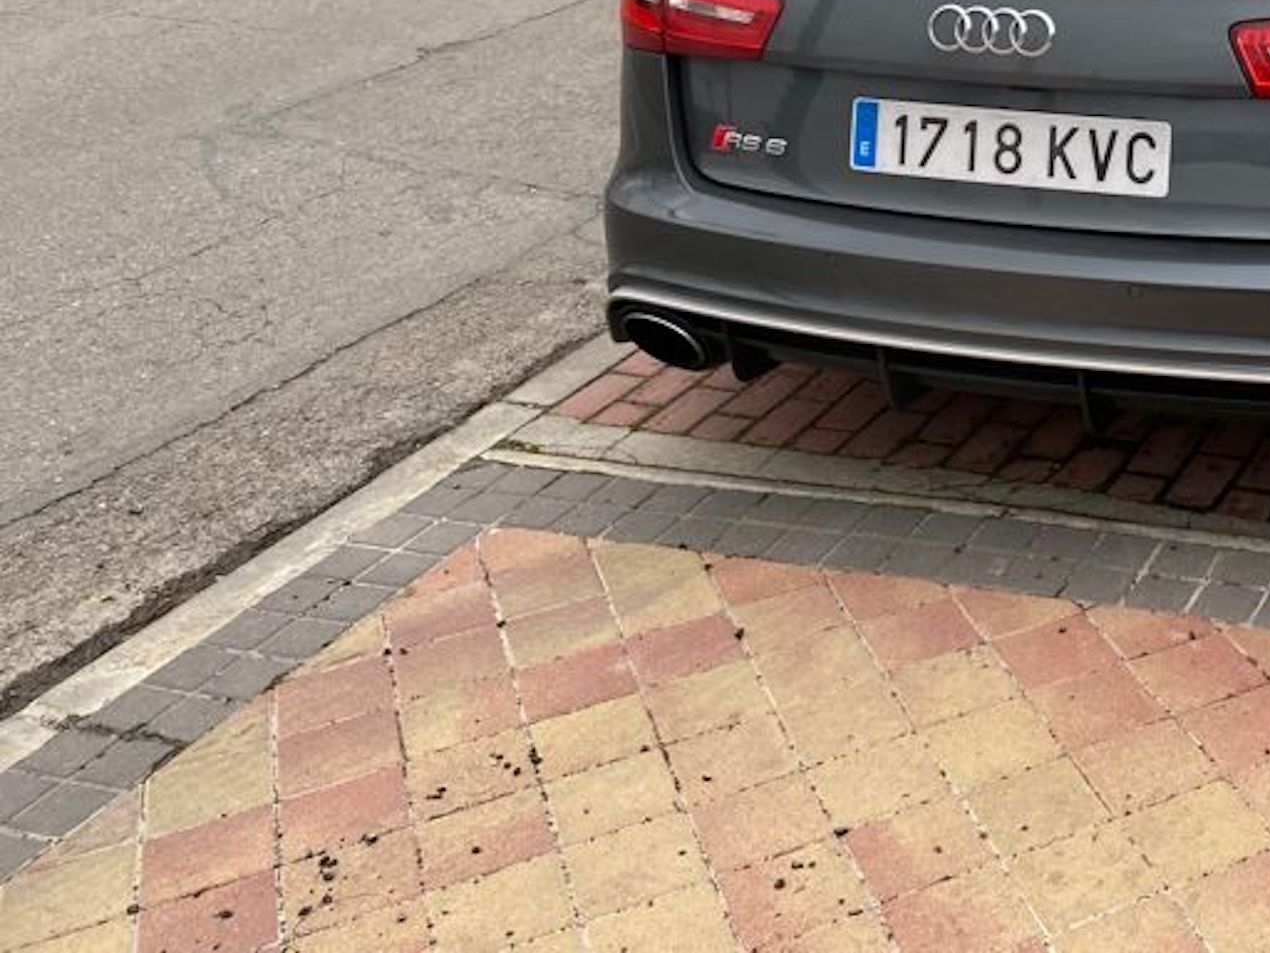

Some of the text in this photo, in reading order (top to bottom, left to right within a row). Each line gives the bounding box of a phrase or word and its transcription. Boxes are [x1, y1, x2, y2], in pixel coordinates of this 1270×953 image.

[860, 141, 870, 157] E
[895, 114, 1157, 185] 1718 KVC
